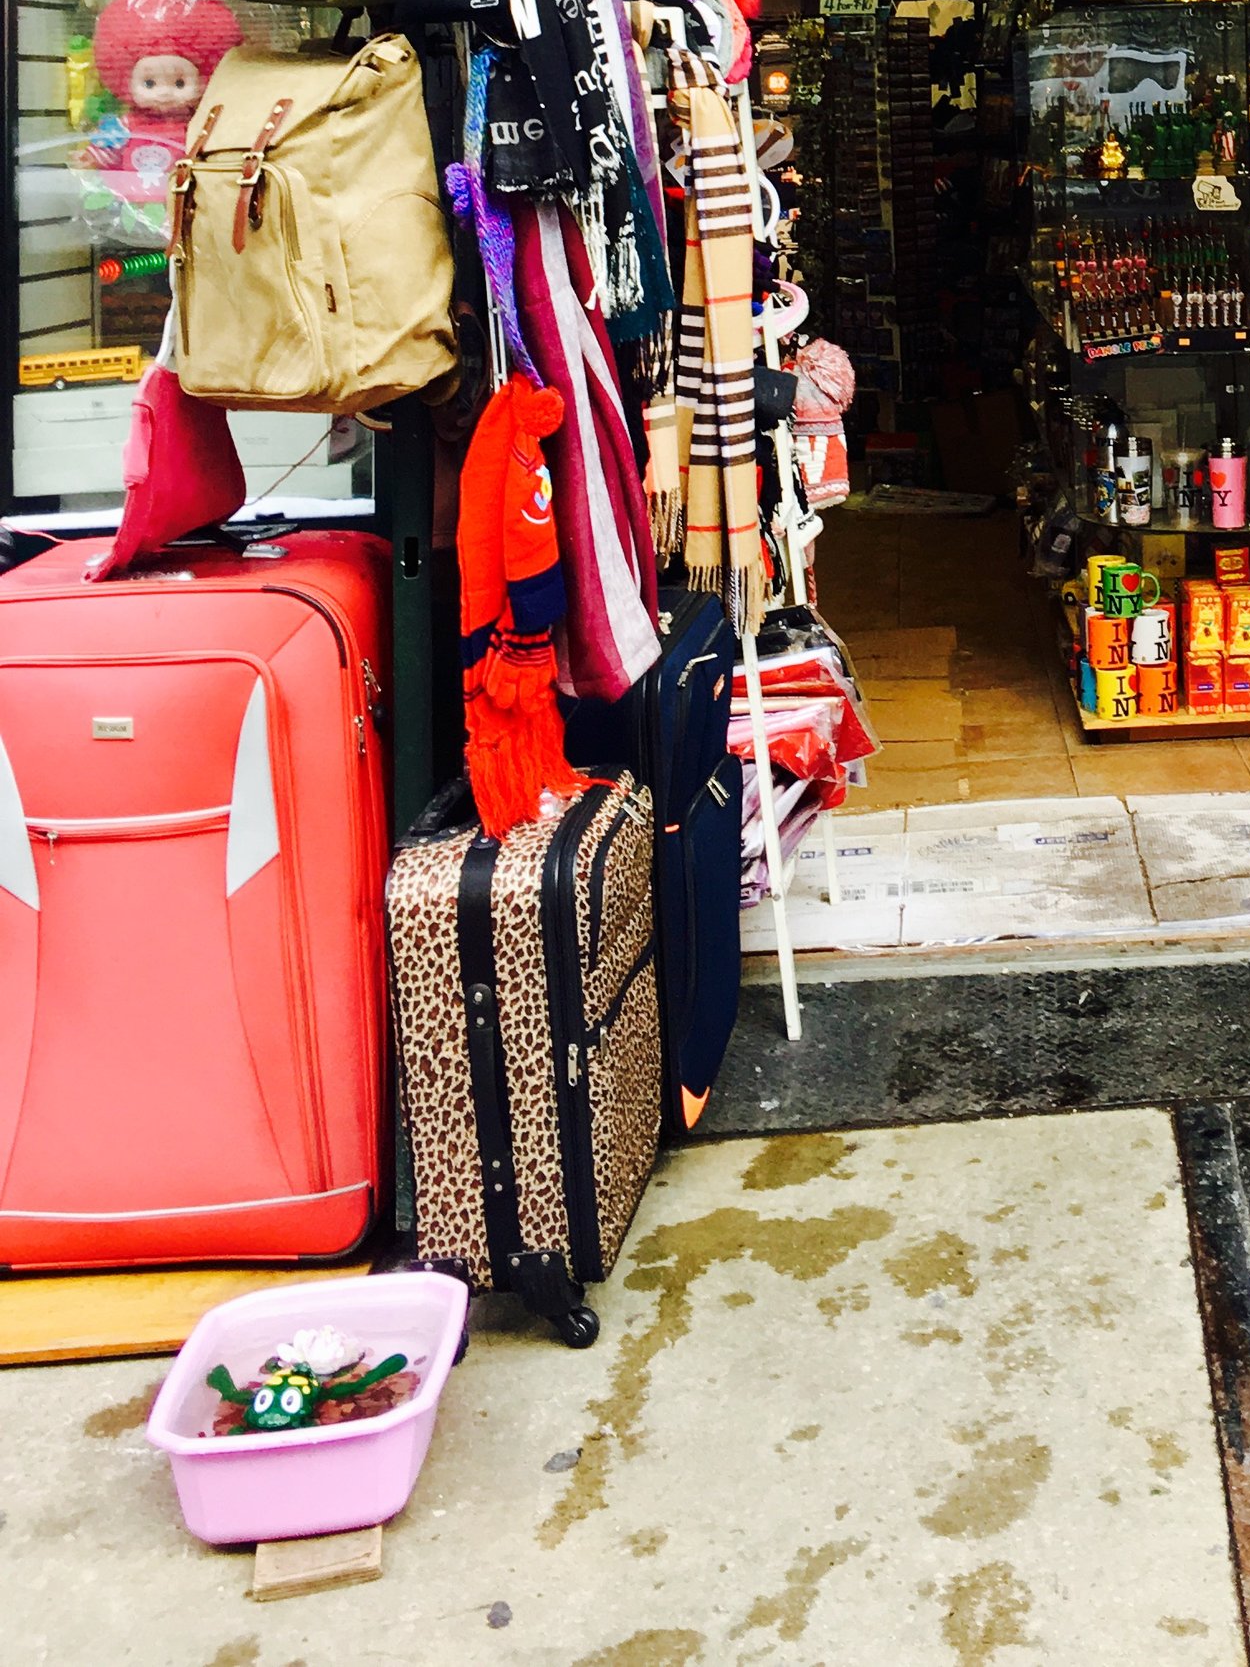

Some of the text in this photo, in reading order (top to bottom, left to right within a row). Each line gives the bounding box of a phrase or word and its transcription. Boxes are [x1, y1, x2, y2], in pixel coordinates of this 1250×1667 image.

[1110, 574, 1120, 593] I
[1106, 594, 1143, 615] NY
[1112, 623, 1122, 642] I
[1157, 620, 1166, 638] I
[1117, 676, 1126, 695] I
[1162, 671, 1172, 690] I
